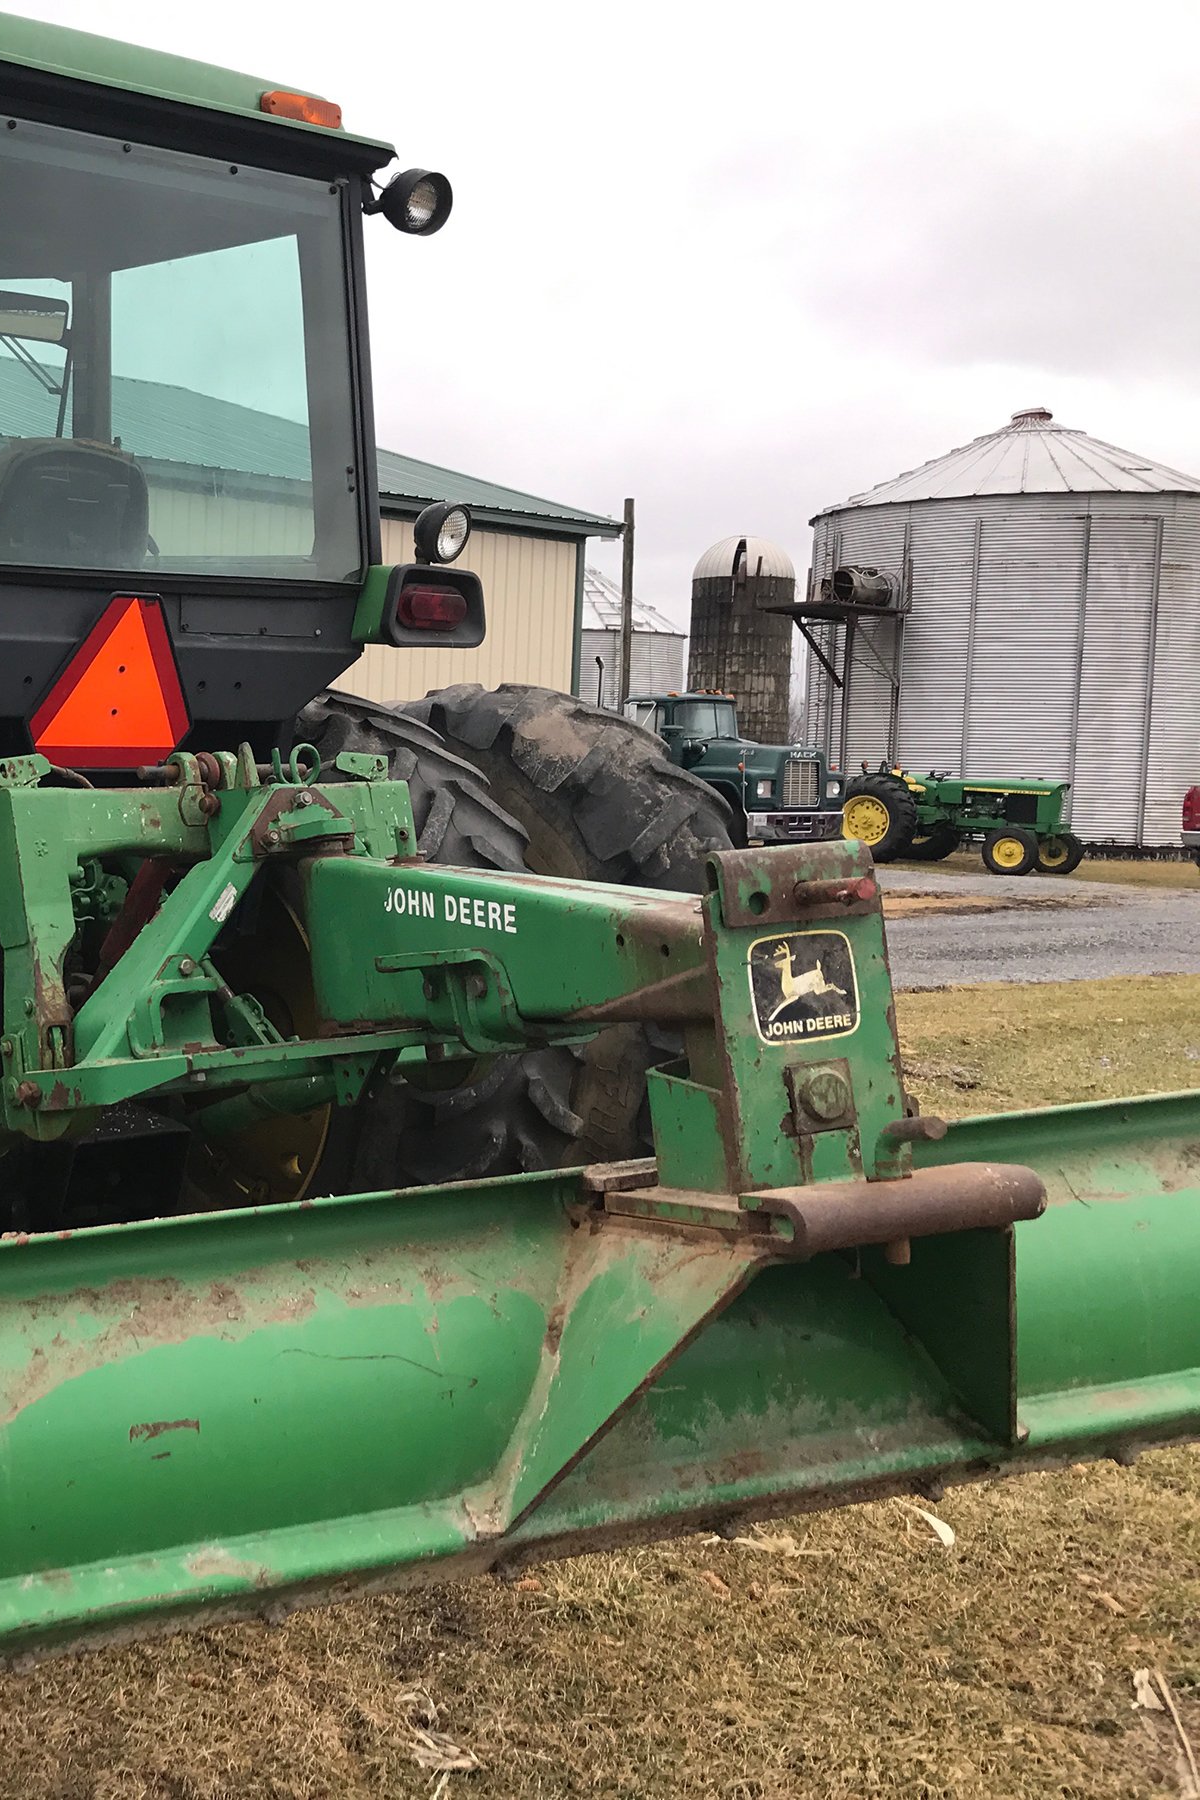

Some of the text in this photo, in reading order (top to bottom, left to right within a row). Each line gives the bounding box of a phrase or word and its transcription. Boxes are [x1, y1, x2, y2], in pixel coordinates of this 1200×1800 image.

[790, 751, 817, 759] MACK
[383, 886, 517, 934] JOHN DEERE
[766, 1013, 852, 1038] JOHN DEERE
